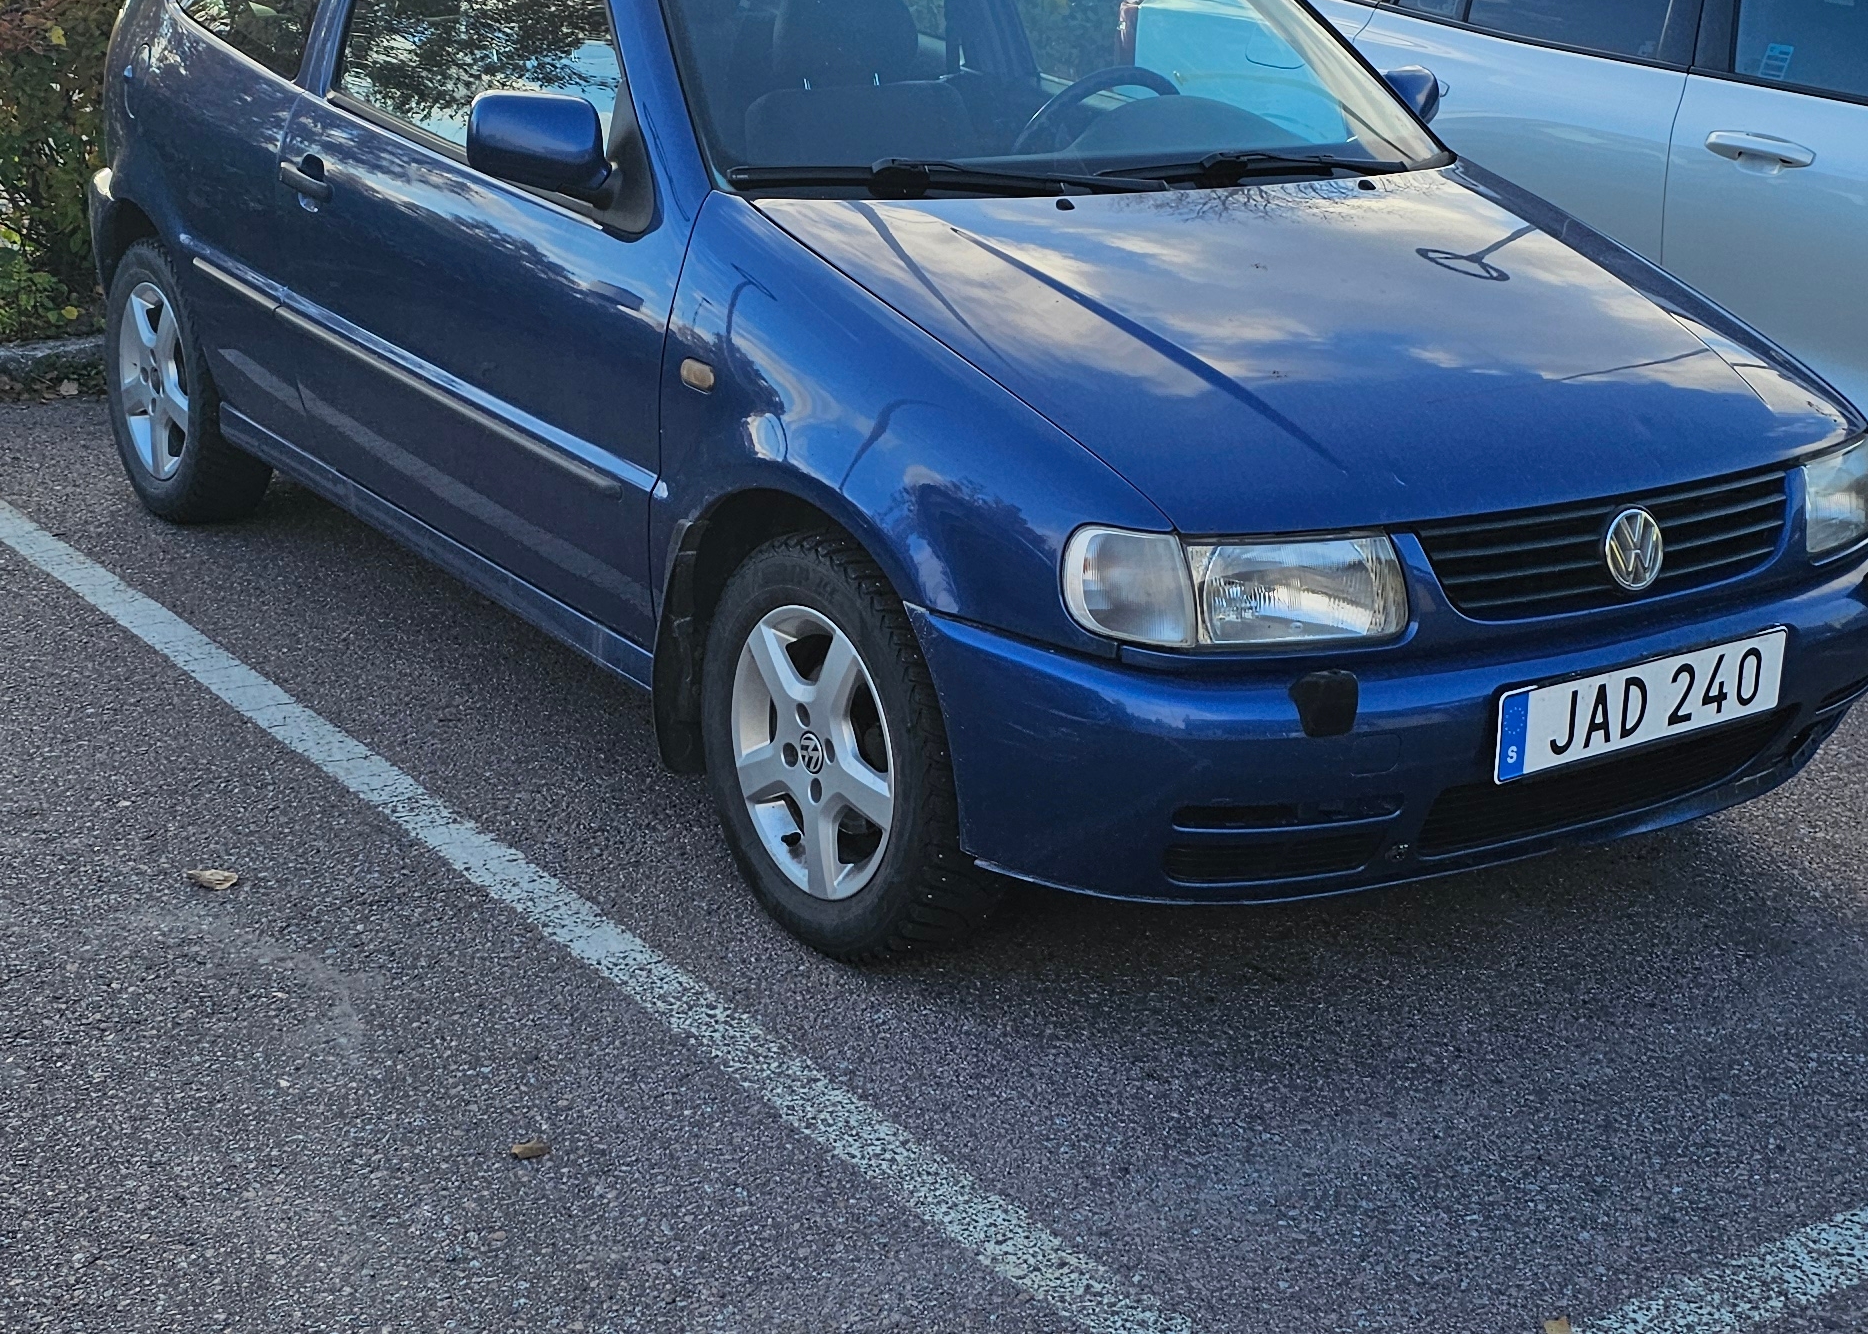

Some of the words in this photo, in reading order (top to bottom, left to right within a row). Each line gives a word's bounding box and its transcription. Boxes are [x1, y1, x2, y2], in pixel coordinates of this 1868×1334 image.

[1550, 677, 1648, 755] JAD
[1668, 647, 1763, 727] 240
[1507, 746, 1517, 763] S
